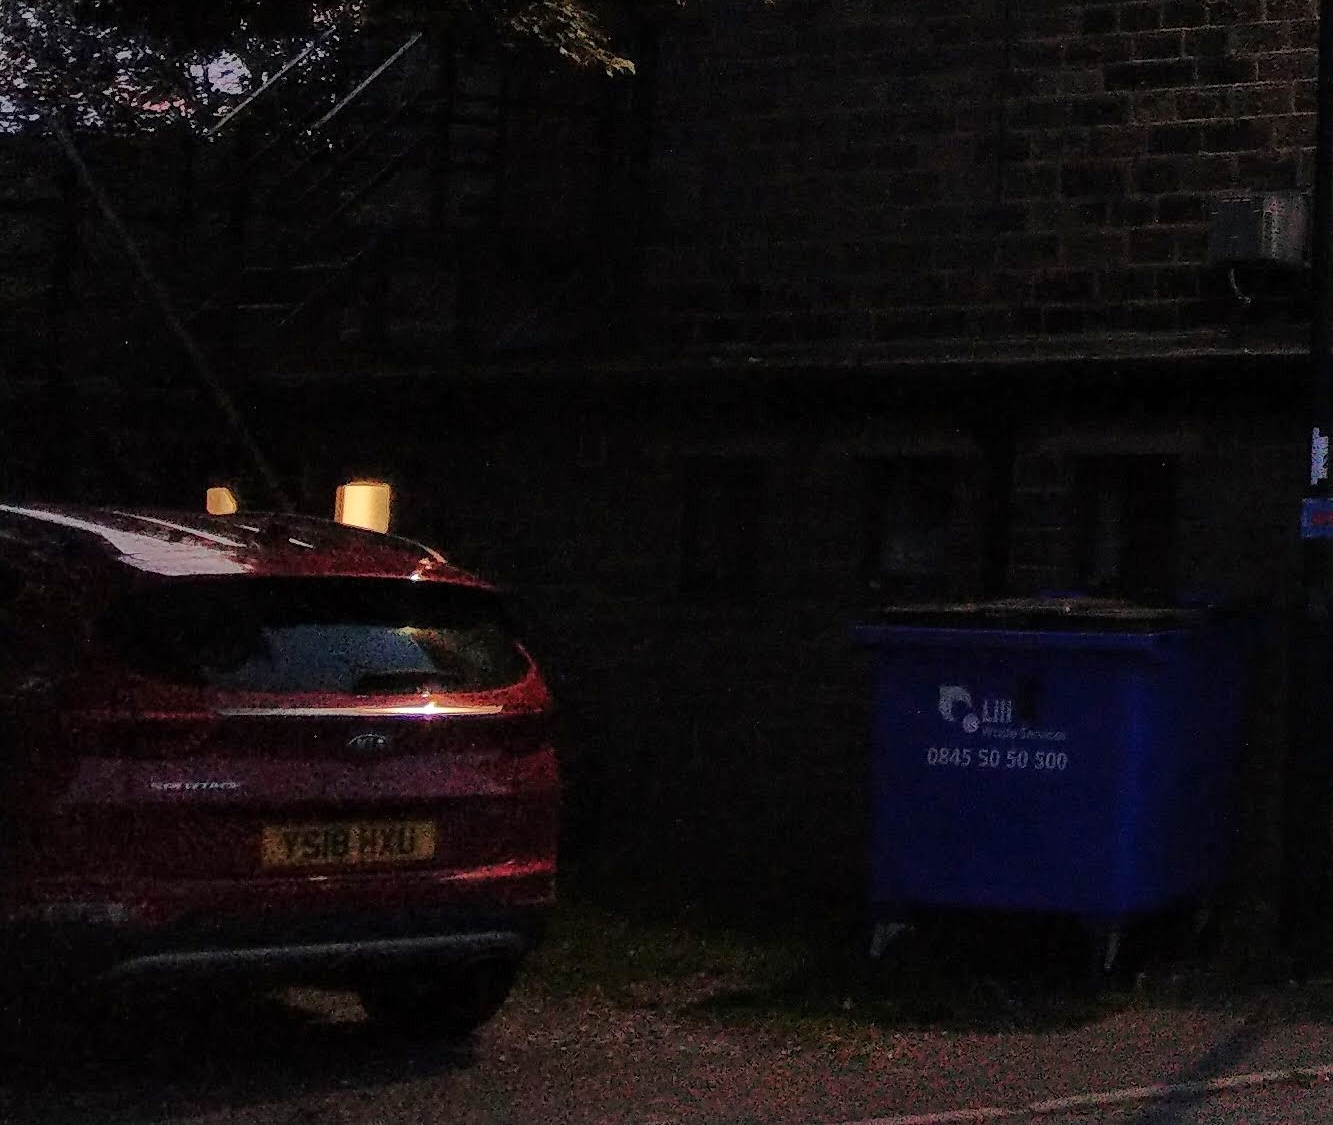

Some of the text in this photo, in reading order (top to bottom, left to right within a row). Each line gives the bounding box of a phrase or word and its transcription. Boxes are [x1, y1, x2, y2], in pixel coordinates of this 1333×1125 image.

[927, 747, 972, 767] 0845
[978, 748, 1000, 768] 50
[1006, 749, 1028, 769] 50
